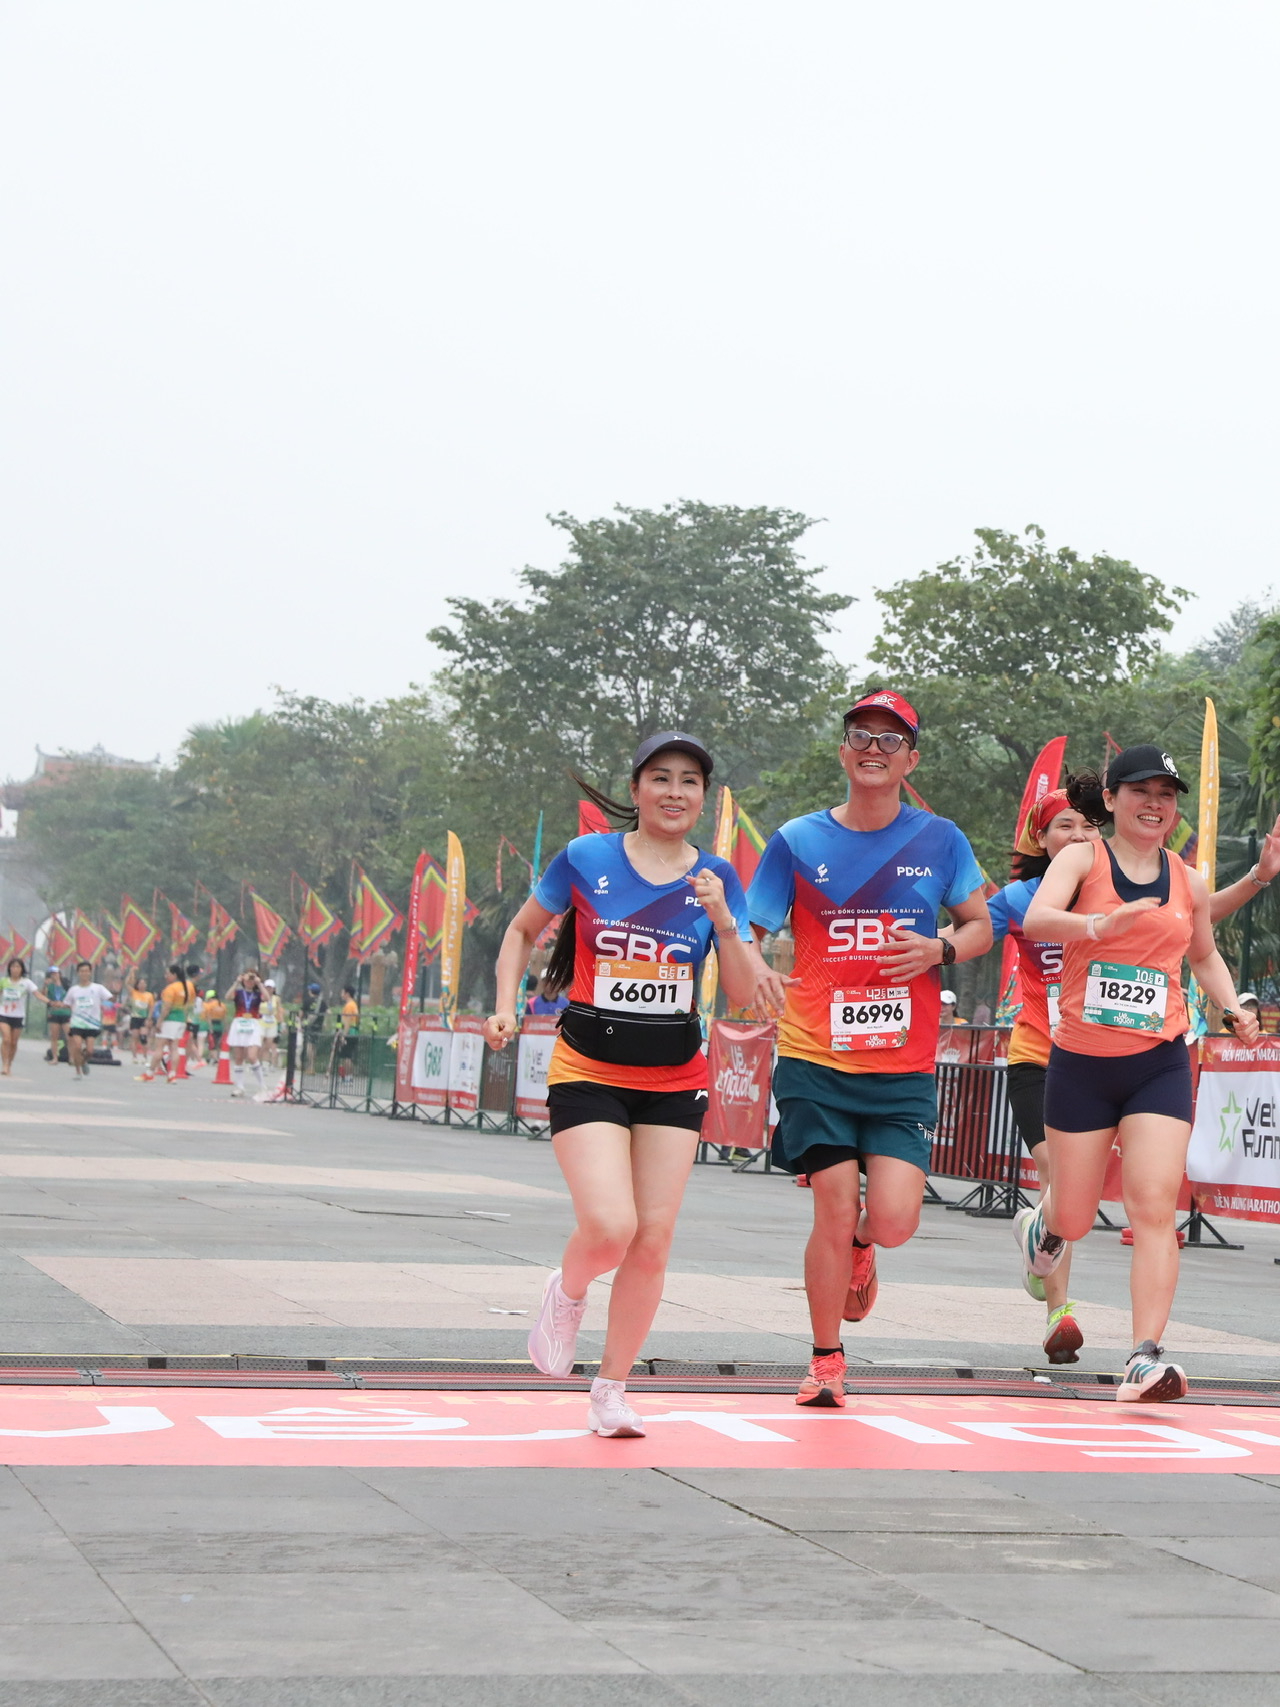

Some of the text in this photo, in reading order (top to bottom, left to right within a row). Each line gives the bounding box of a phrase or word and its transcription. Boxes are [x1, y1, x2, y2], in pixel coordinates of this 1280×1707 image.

[684, 896, 702, 907] PD
[631, 924, 655, 934] DOANH
[595, 930, 692, 964] SBC
[609, 982, 678, 1003] 66011
[1099, 981, 1156, 1005] 18229
[842, 1003, 904, 1025] 86996
[1246, 1096, 1276, 1128] Viet
